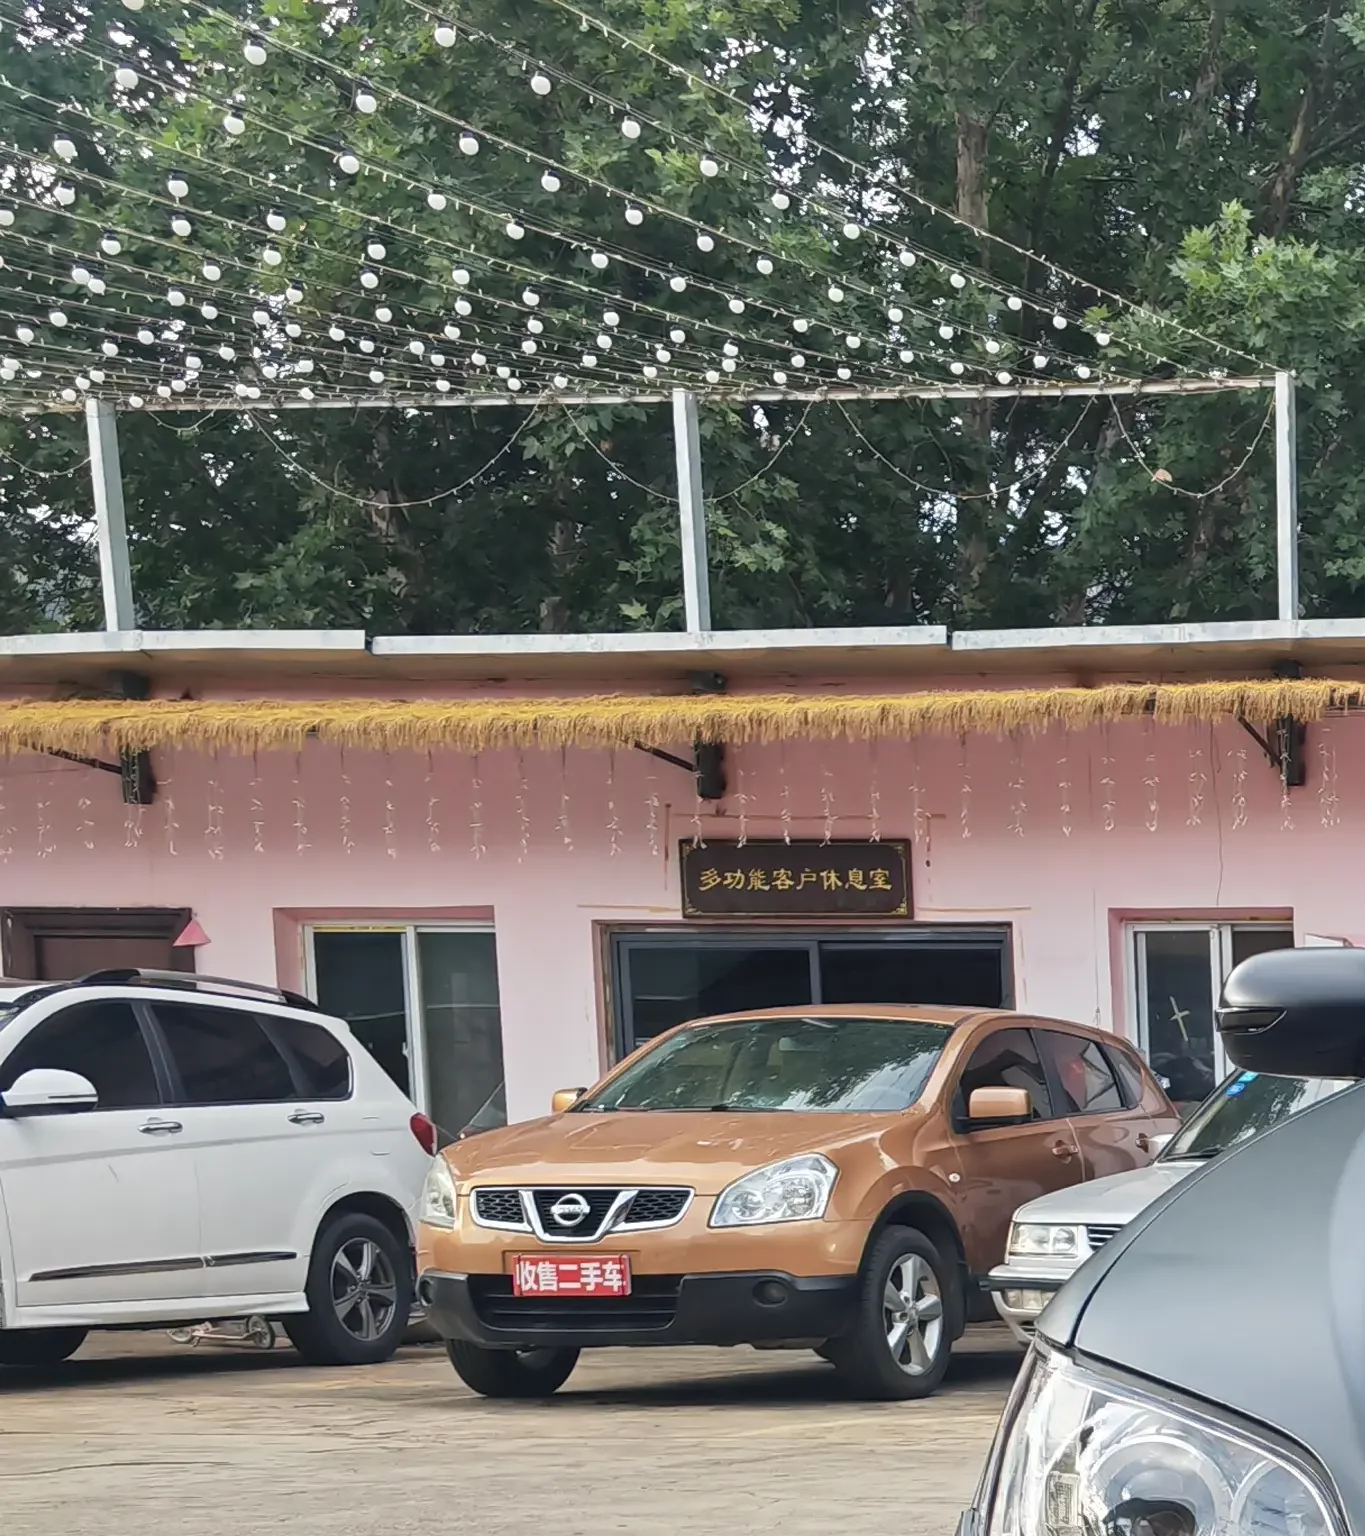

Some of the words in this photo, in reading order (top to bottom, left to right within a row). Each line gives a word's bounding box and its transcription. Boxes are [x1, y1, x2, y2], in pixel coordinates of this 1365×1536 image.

[698, 867, 892, 891] 多功能客户休息室
[516, 1261, 627, 1292] 收售二手车
